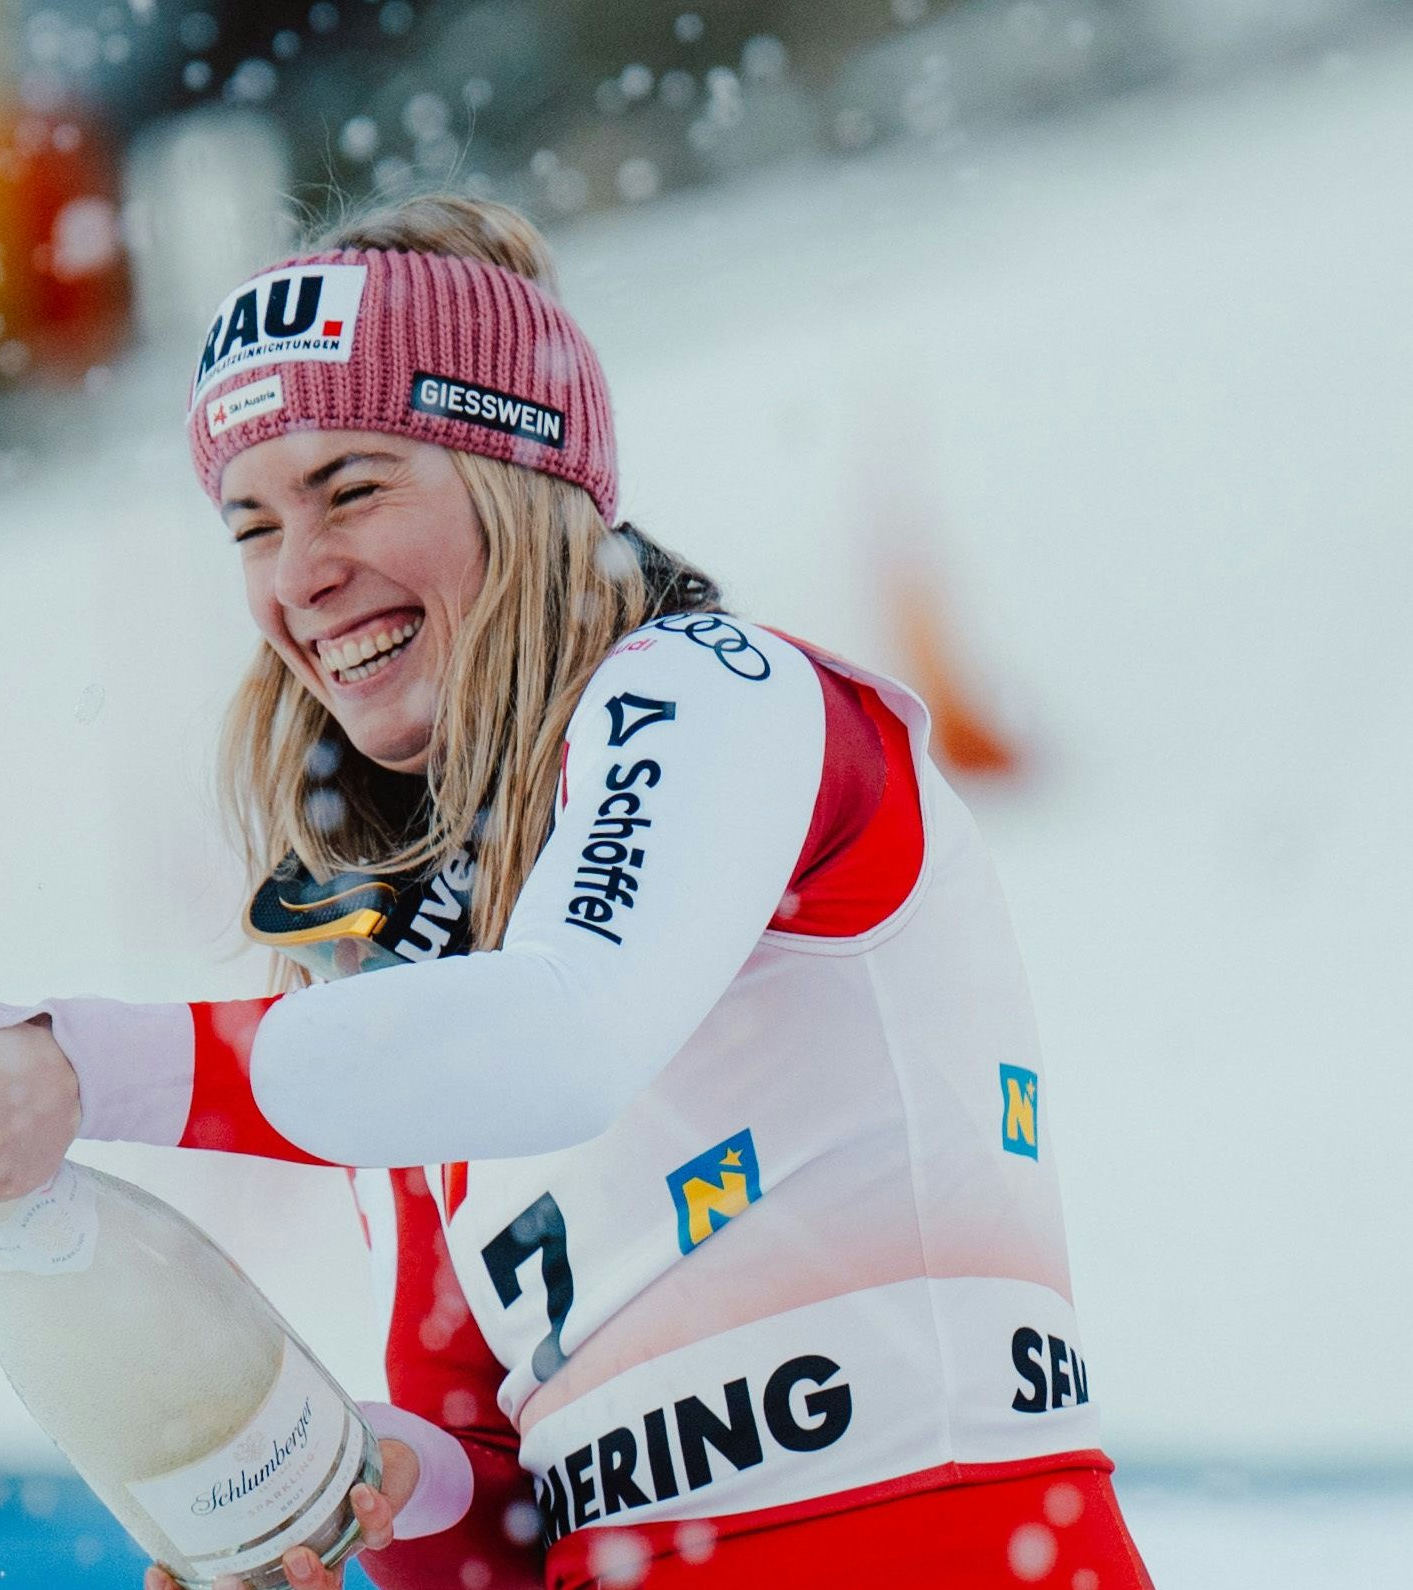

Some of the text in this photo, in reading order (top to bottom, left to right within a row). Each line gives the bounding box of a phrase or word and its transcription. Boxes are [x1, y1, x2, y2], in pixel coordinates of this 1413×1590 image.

[229, 390, 276, 414] Ski Austria
[420, 378, 562, 441] GIESSWEIN
[565, 758, 662, 946] Schöffel
[481, 1190, 575, 1383] 7
[190, 1396, 313, 1516] Schlumberger
